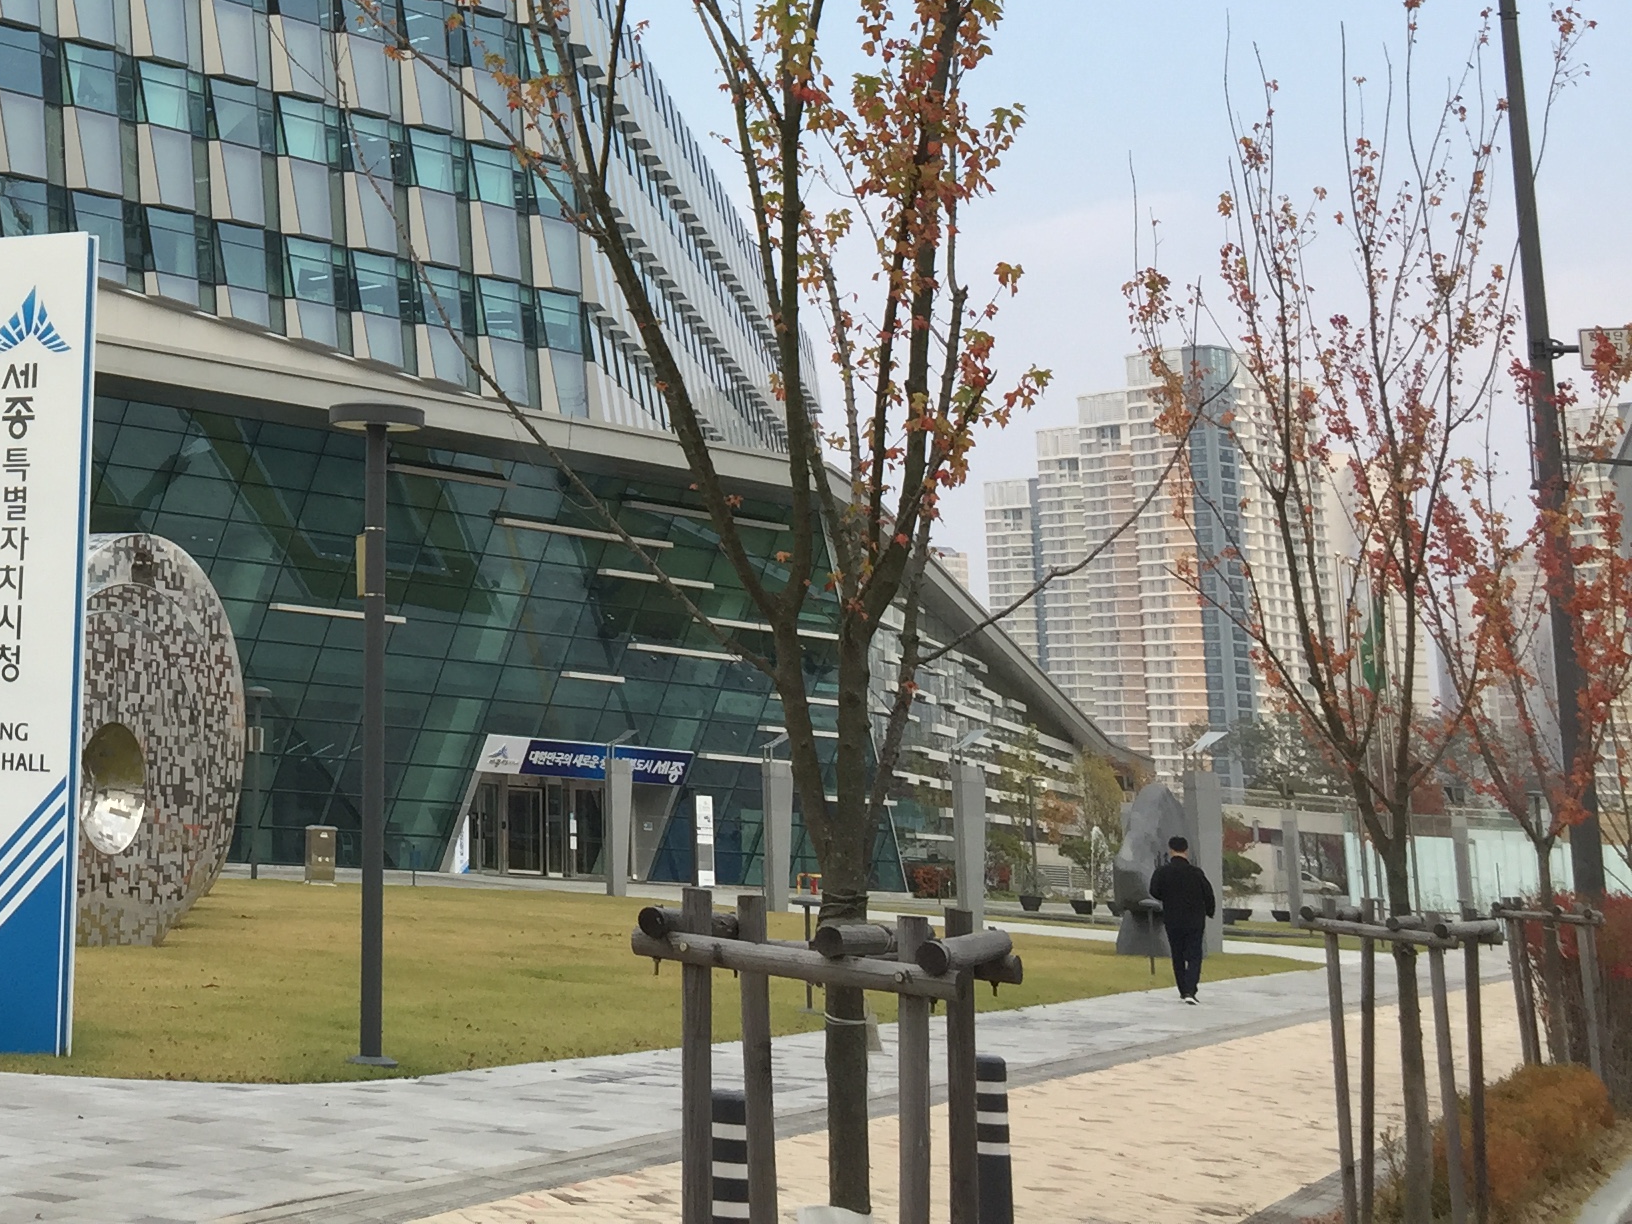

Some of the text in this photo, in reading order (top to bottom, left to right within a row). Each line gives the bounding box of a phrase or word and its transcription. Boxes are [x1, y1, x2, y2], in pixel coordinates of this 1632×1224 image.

[1, 752, 51, 773] HALL
[528, 749, 574, 768] 대한민국의
[651, 759, 685, 784] 세종
